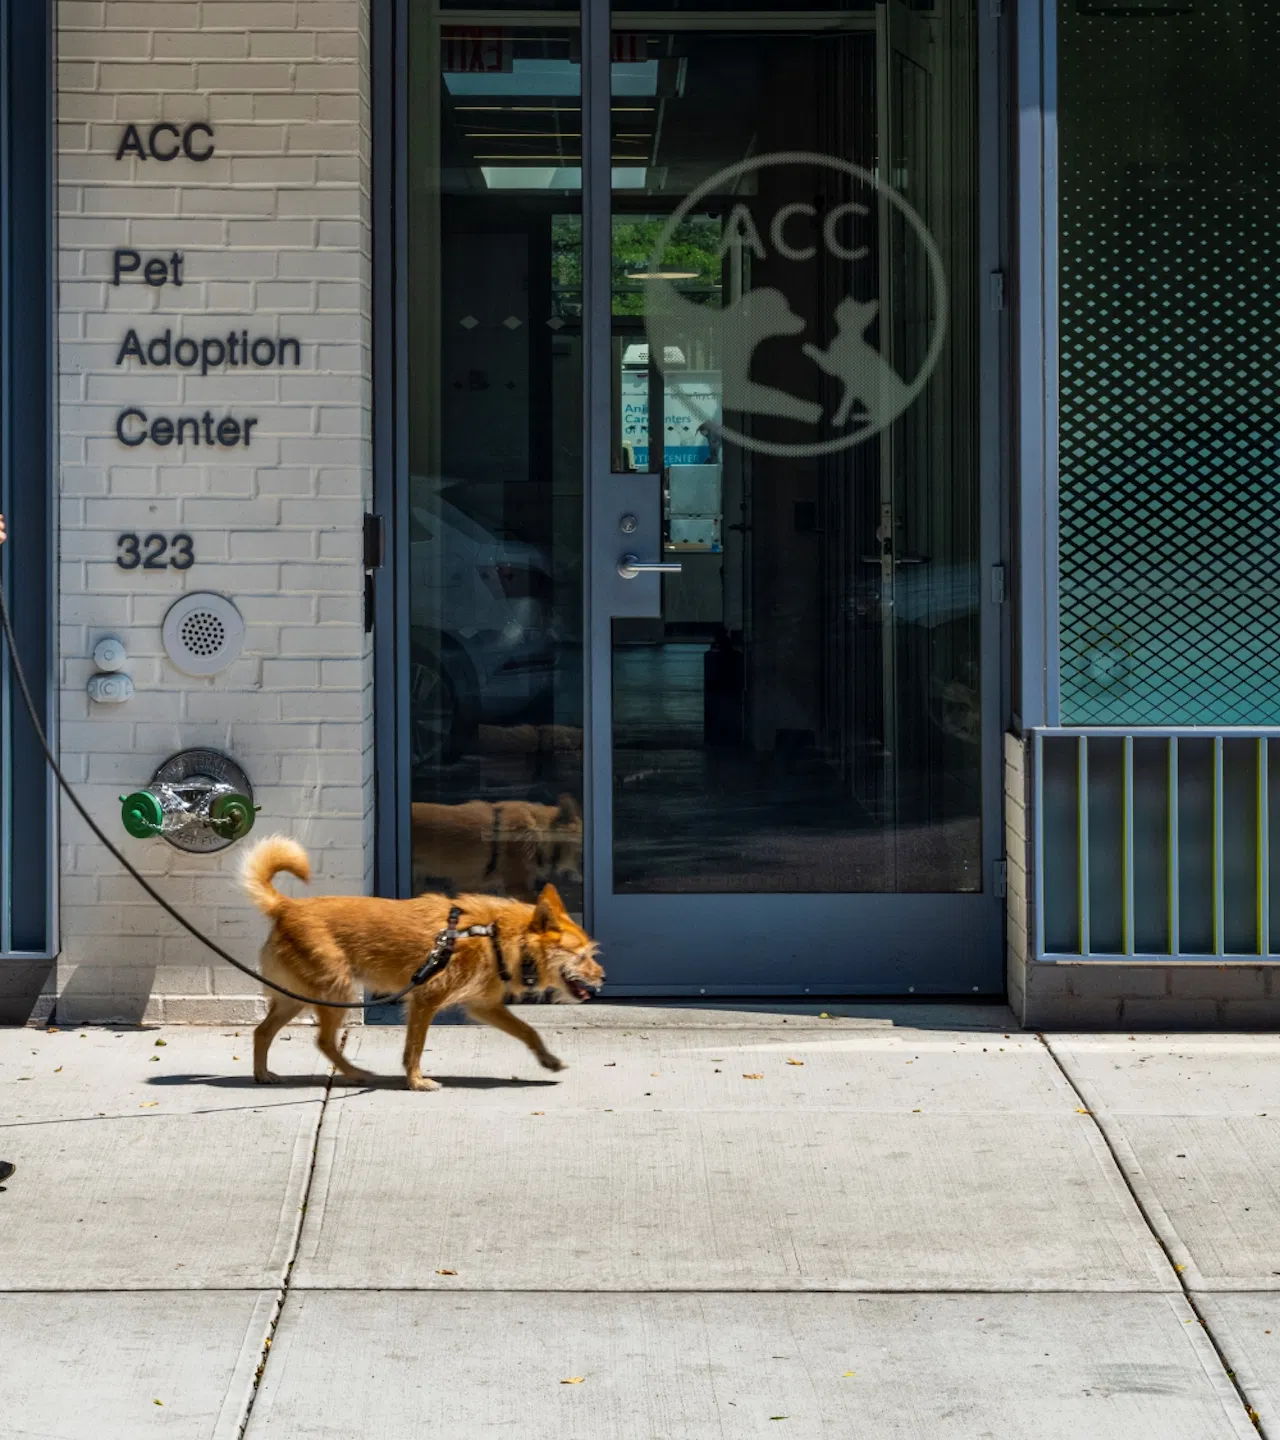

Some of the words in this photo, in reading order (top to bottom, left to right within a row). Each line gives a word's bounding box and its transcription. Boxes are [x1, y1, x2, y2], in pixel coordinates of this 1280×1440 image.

[116, 123, 215, 162] ACC
[721, 203, 869, 260] ACC
[113, 249, 184, 287] Pet
[116, 328, 302, 376] Adoption
[116, 408, 259, 447] Center
[116, 533, 195, 570] 323
